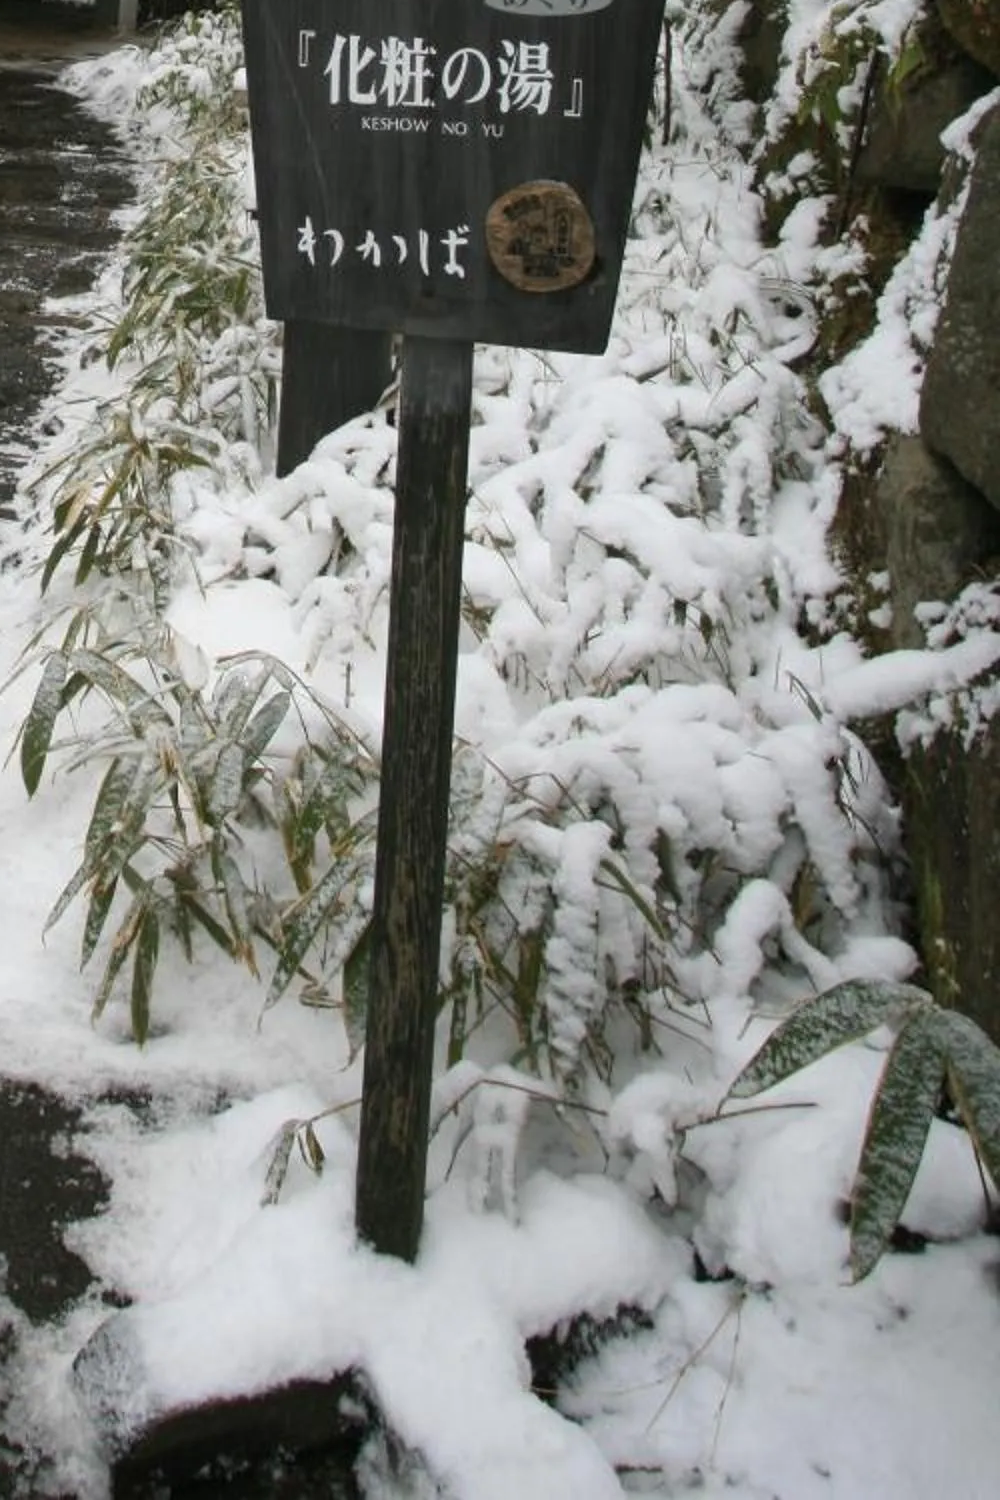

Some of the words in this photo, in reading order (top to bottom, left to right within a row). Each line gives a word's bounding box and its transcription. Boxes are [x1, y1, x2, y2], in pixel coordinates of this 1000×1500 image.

[298, 29, 584, 118] 『化粧の湯』
[360, 116, 430, 133] KESHOW
[441, 121, 468, 137] NO
[481, 123, 505, 139] YU
[296, 214, 472, 280] わかば
